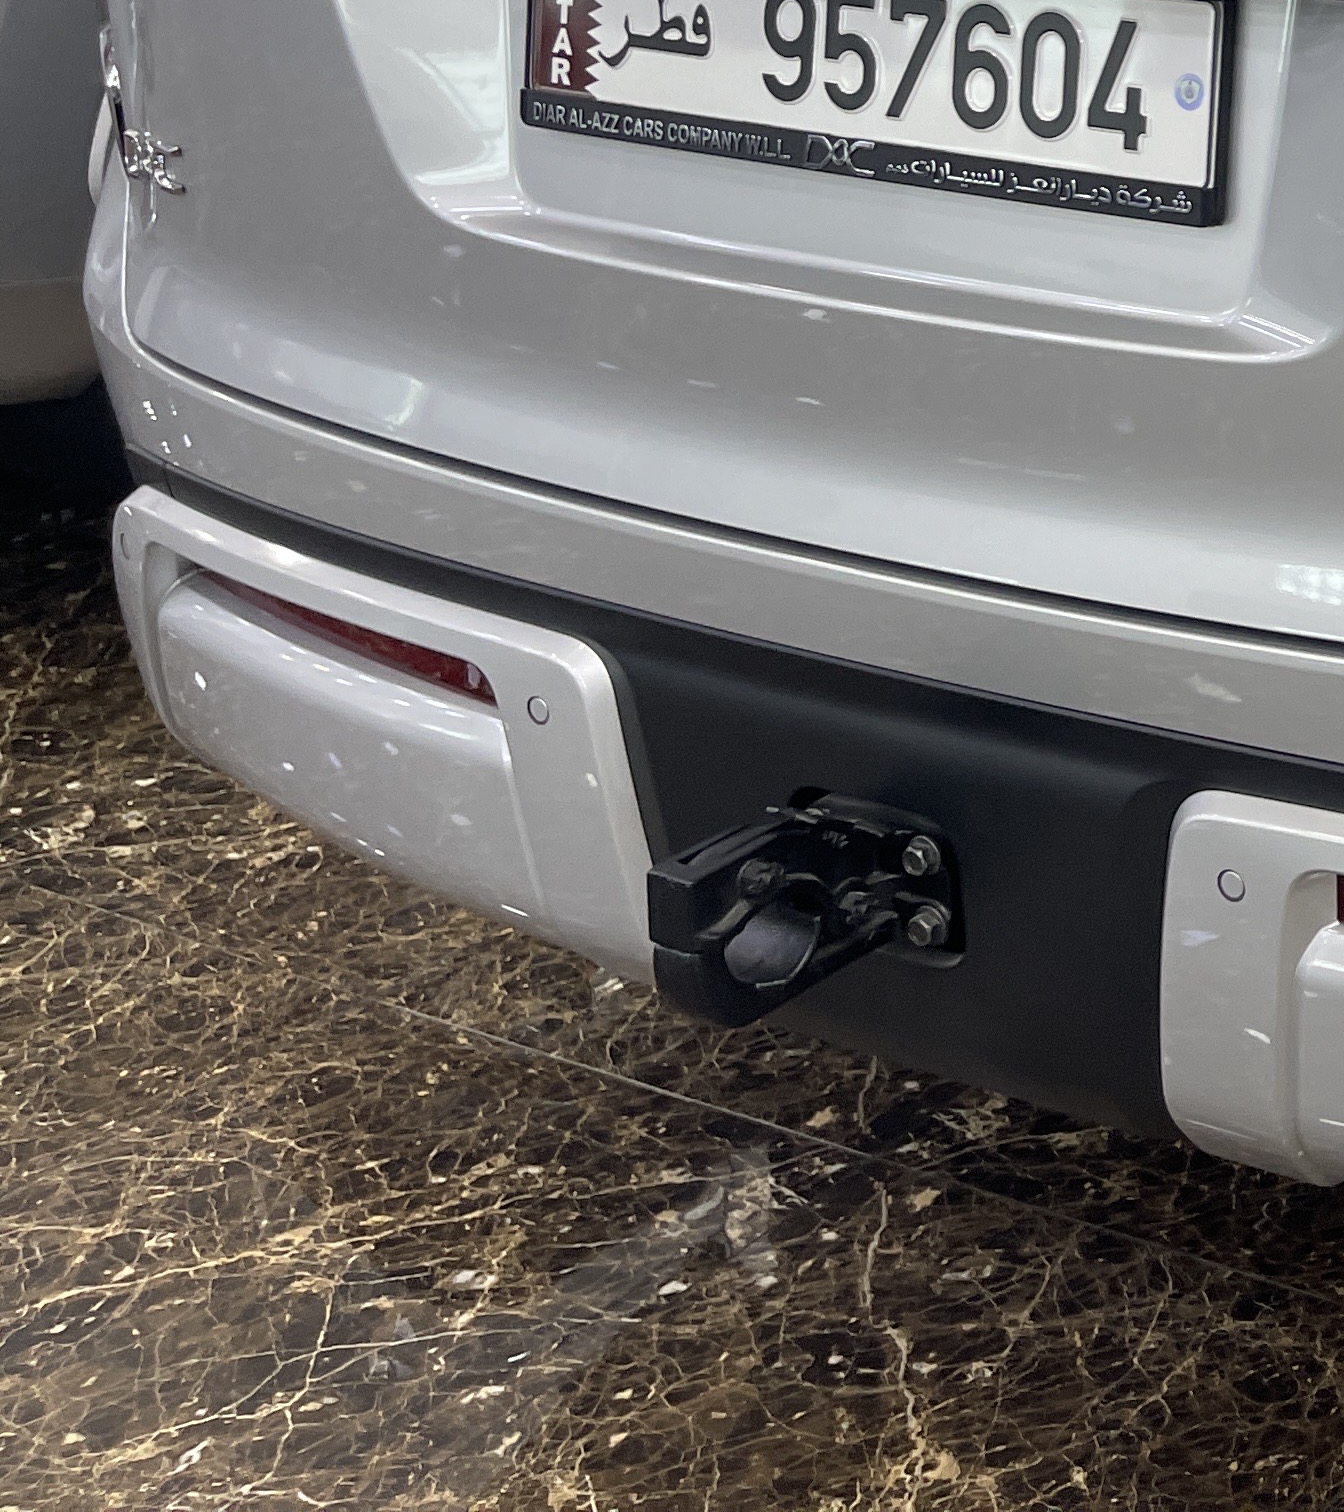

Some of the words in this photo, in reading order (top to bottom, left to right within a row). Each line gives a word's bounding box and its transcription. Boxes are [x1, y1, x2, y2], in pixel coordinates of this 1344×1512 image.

[533, 102, 566, 125] DIAR
[569, 109, 620, 133] AL-AZZ
[623, 116, 664, 141] CARS
[667, 123, 743, 153] COMPANY
[1116, 184, 1194, 215] شركة
